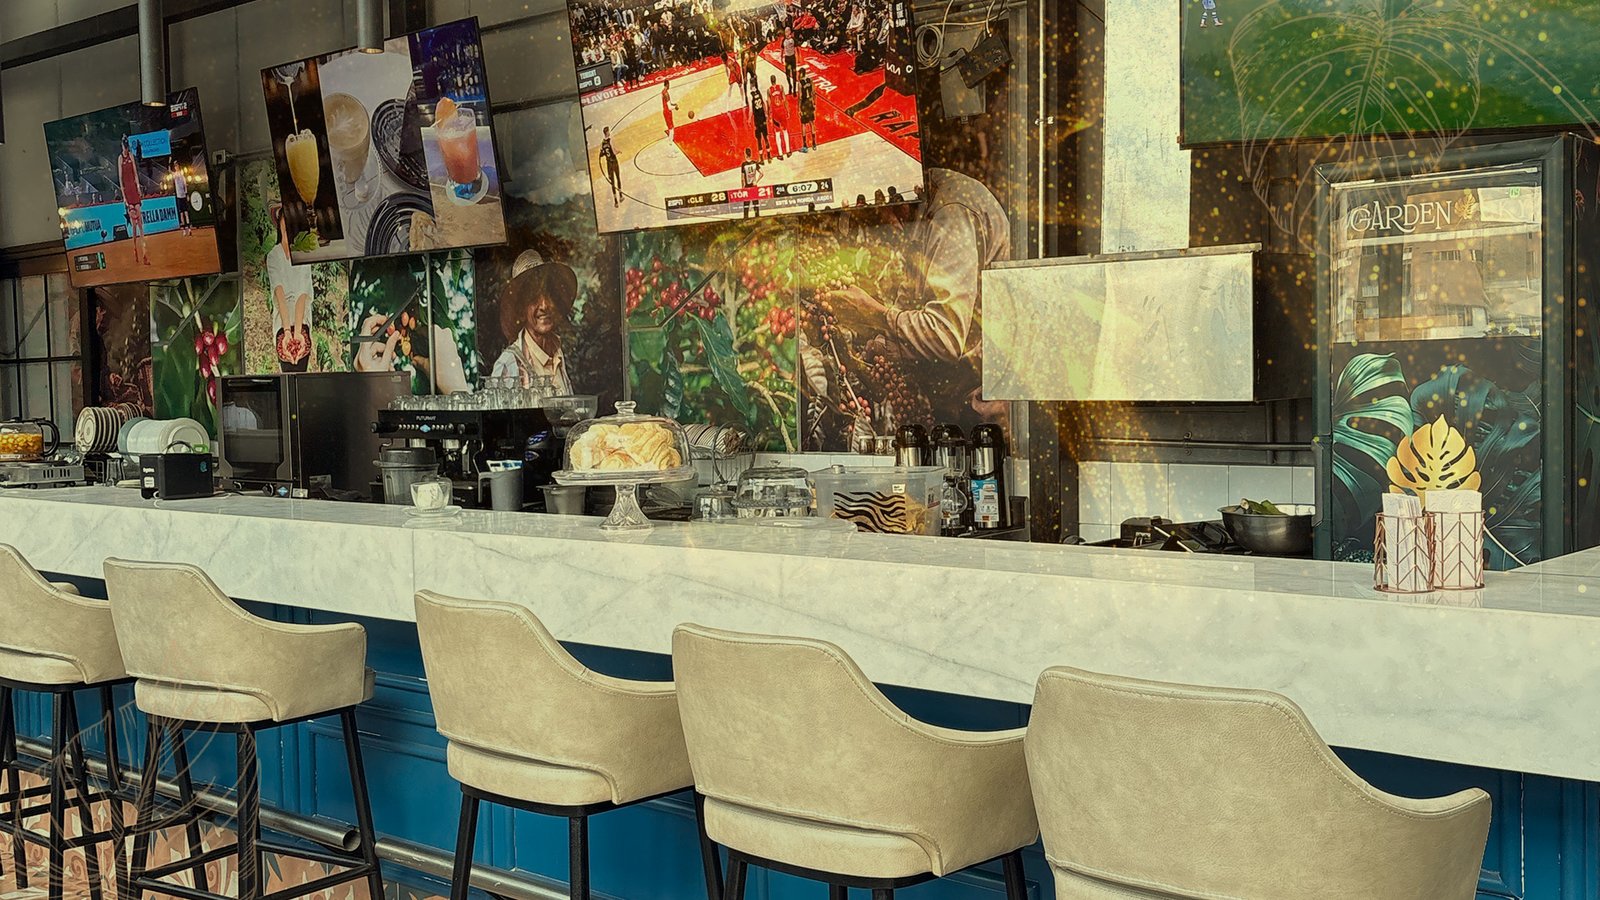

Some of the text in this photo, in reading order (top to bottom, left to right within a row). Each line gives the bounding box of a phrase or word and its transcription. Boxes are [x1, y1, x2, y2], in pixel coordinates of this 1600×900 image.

[655, 67, 697, 82] Google
[690, 196, 704, 204] CLE
[711, 192, 726, 202] 28
[758, 187, 771, 197] 21
[792, 184, 812, 193] 6:07
[1350, 201, 1452, 232] GARDEN
